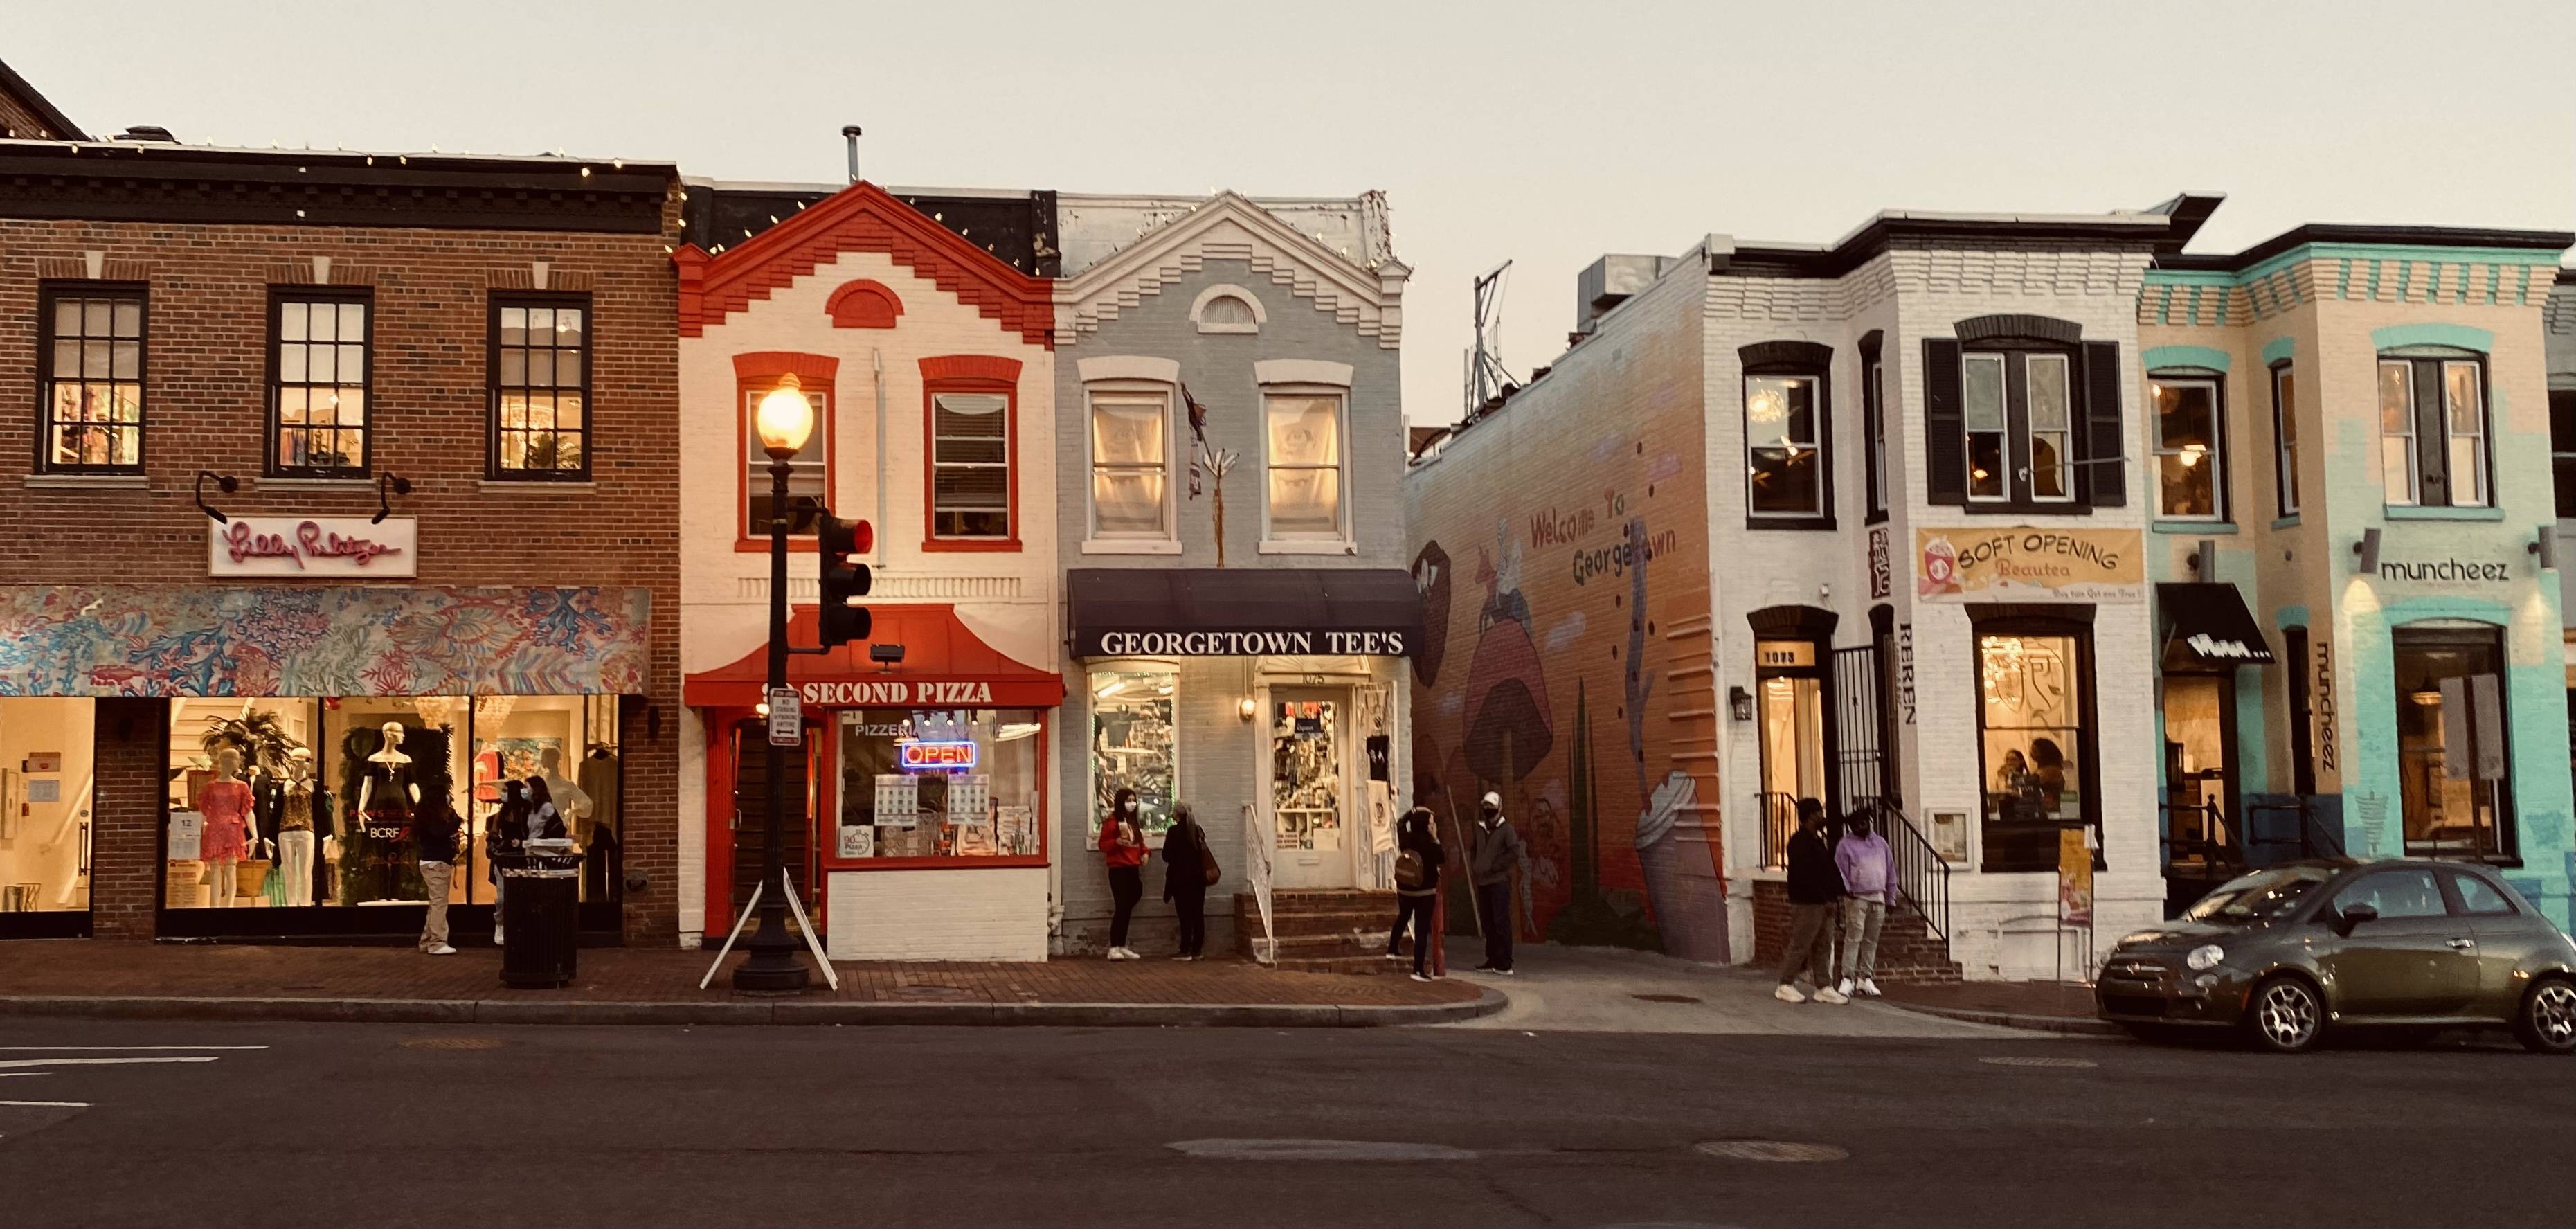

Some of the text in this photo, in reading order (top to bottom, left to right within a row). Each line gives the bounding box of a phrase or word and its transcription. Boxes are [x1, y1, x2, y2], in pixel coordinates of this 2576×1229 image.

[1531, 487, 1625, 549] Welcome To
[222, 521, 305, 570] Lilly
[1958, 534, 2119, 570] SOFT OPENING
[1994, 558, 2071, 577] Beautea
[2381, 557, 2510, 581] muncheez
[1101, 631, 1403, 655] GEORGETOWN TEE'S
[1302, 673, 1325, 685] 1075
[1900, 623, 1917, 725] REREN
[802, 682, 908, 704] SECOND
[916, 682, 993, 704] PIZZA
[2316, 641, 2335, 772] muncheez
[906, 745, 972, 764] OPEN
[370, 827, 401, 838] BCRF
